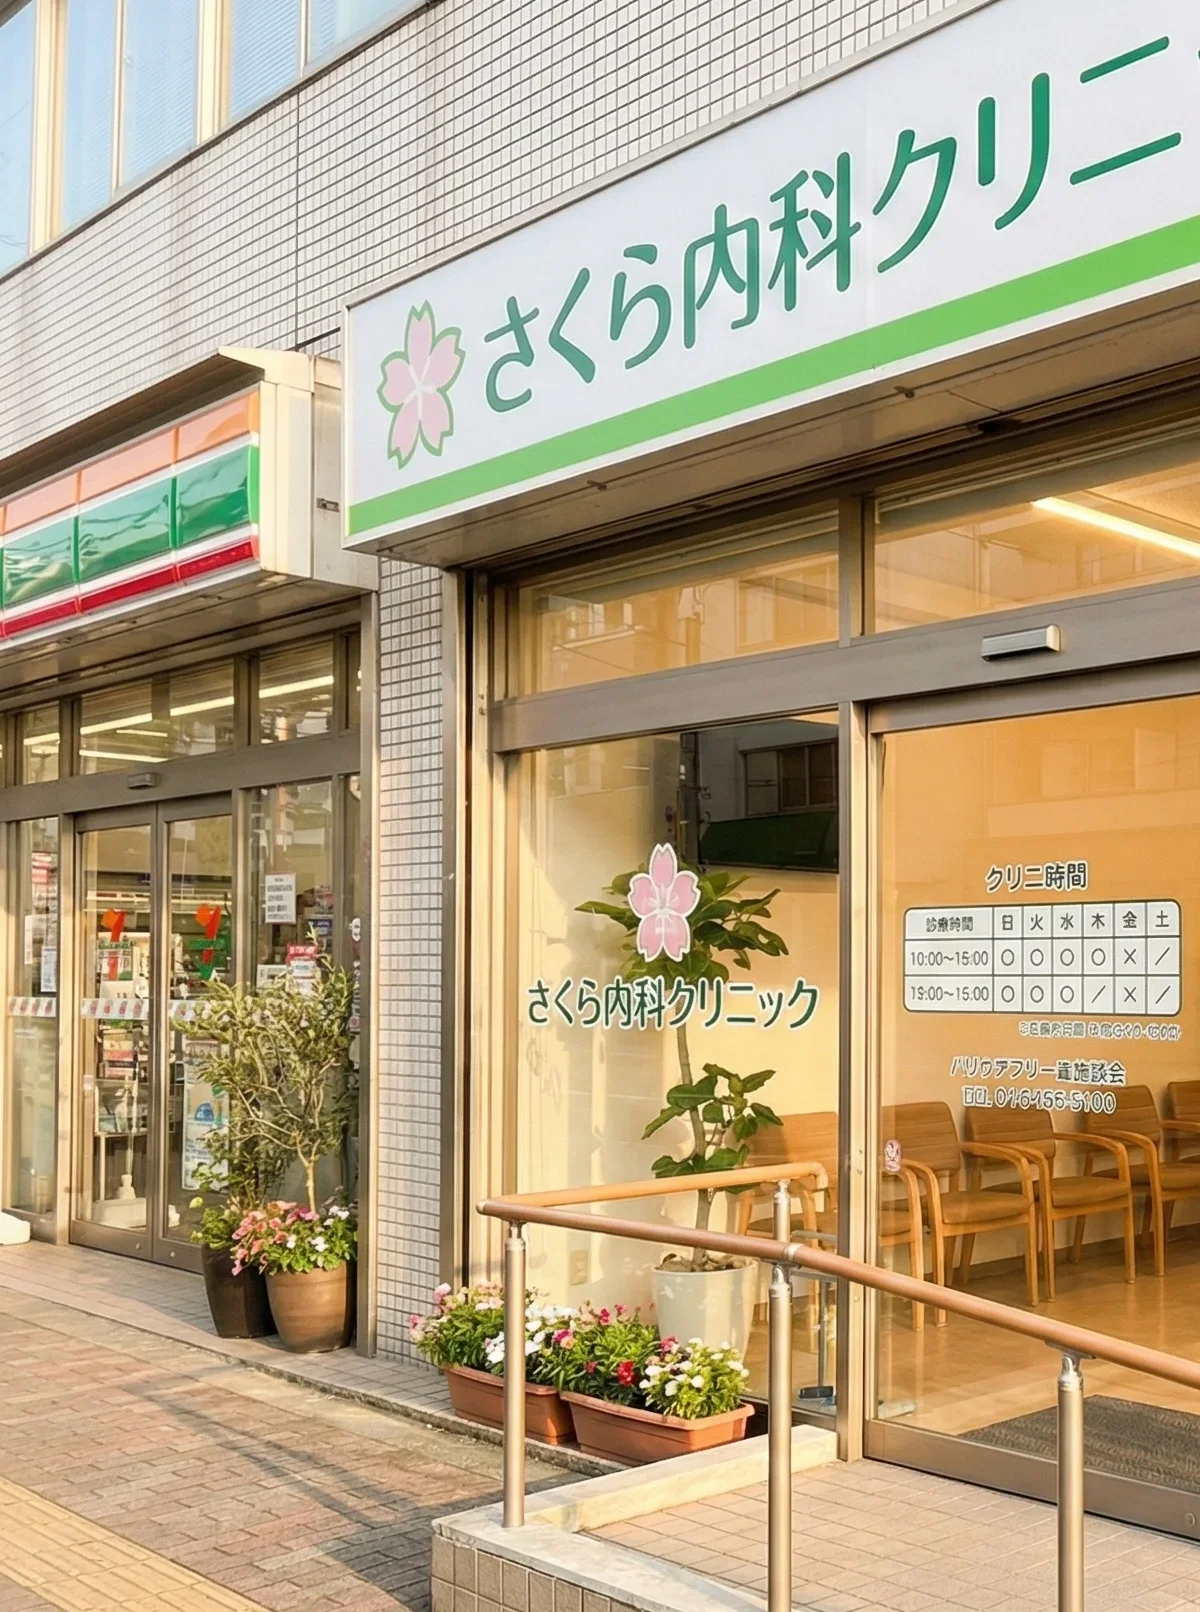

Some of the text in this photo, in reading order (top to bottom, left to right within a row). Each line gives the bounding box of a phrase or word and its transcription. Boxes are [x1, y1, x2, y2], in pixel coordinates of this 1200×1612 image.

[1030, 914, 1044, 931] 火
[1060, 912, 1075, 930] 水
[1091, 912, 1106, 930] 木
[1122, 910, 1138, 929] 金
[1155, 910, 1170, 928] 土
[527, 974, 819, 1029] さくら内科クリニック
